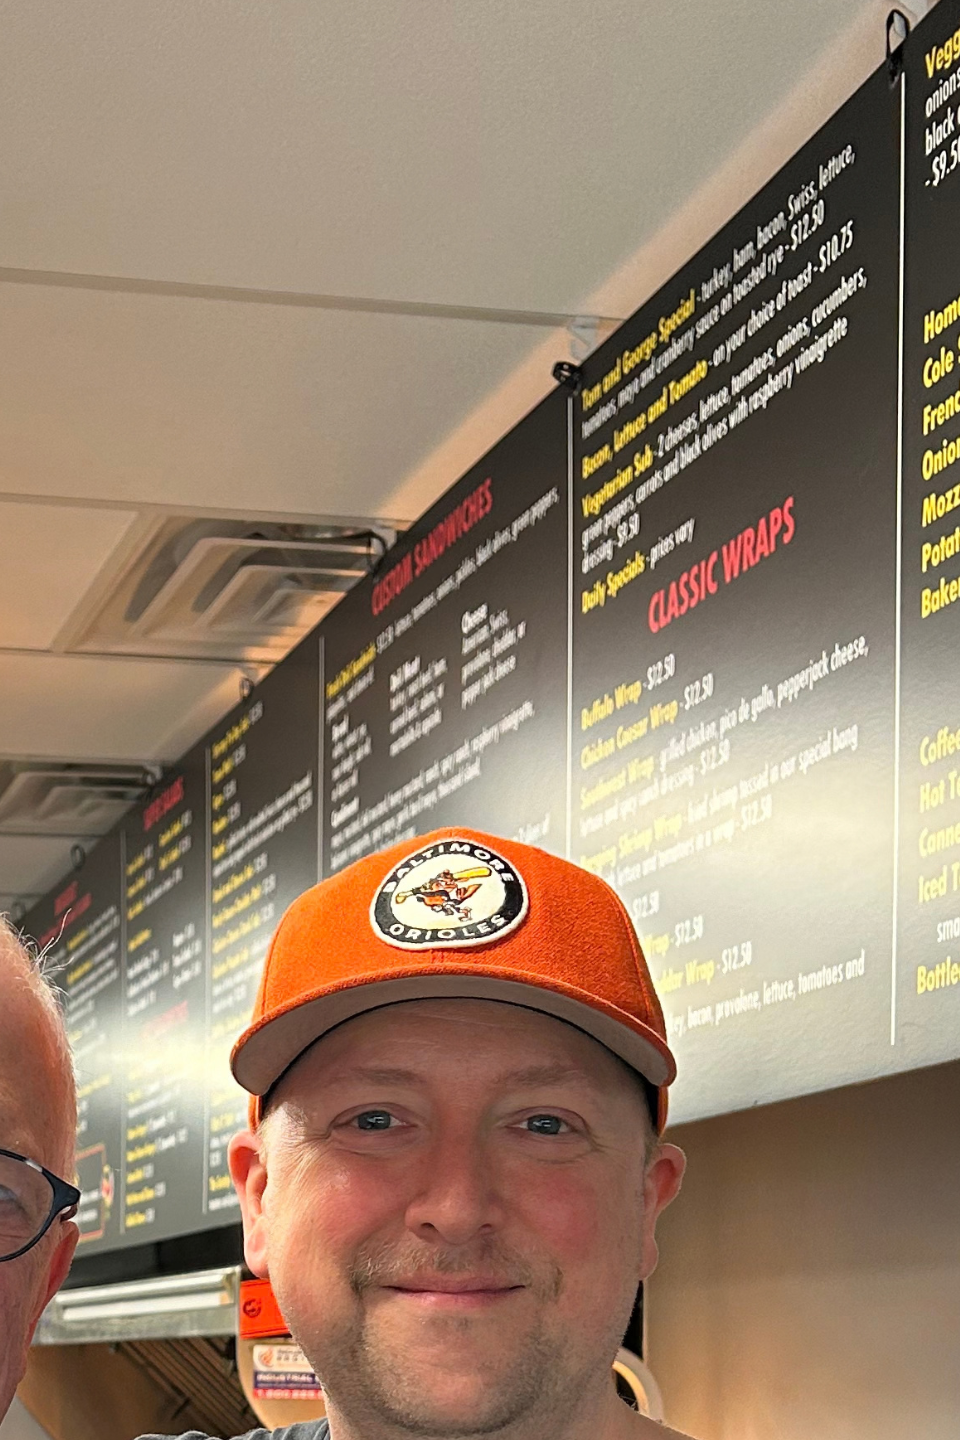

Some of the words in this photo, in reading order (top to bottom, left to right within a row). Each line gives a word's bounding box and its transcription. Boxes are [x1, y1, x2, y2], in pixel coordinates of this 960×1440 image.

[926, 106, 955, 156] black
[602, 358, 622, 393] and
[622, 332, 658, 374] George
[658, 289, 695, 342] Special
[701, 263, 733, 302] turkey,
[733, 241, 756, 272] ham,
[757, 212, 787, 250] bacon,
[787, 181, 818, 221] Swiss,
[818, 145, 855, 190] lettuce,
[655, 328, 695, 374] cranberry
[695, 305, 720, 339] sauce
[720, 293, 733, 316] on
[732, 253, 767, 304] toasted
[767, 245, 784, 275] rye
[790, 199, 825, 251] $12.50
[582, 445, 613, 479] Bacon,
[613, 413, 647, 452] Lettuce
[647, 387, 668, 423] and
[668, 360, 708, 404] Tomato
[712, 344, 726, 367] on
[725, 325, 747, 362] your
[747, 300, 775, 337] choice
[776, 280, 787, 311] of
[787, 262, 812, 301] toast
[819, 220, 853, 273] $10.75
[923, 346, 955, 388] Cole
[581, 466, 633, 517] Vegetarian
[633, 445, 654, 477] Sub
[657, 434, 665, 458] 2
[664, 413, 698, 452] cheeses,
[699, 387, 731, 422] lettuce,
[731, 348, 776, 396] tomatoes,
[776, 317, 811, 358] onions,
[811, 268, 867, 327] cucumbers,
[635, 470, 665, 504] carrots
[663, 451, 680, 482] and
[679, 434, 702, 469] black
[701, 418, 728, 451] olives
[728, 396, 749, 429] with
[748, 363, 794, 413] raspberry
[794, 318, 848, 373] vinaigrette
[371, 555, 413, 615] CUSTOM
[414, 480, 493, 575] SANDWICHES
[581, 581, 607, 614] Daily
[606, 552, 645, 597] Specials
[650, 533, 675, 569] prices
[674, 519, 695, 545] vary
[648, 553, 718, 633] CLASSIC
[721, 496, 796, 584] WRAPS
[922, 576, 960, 619] Bake
[580, 694, 615, 731] Buffalo
[614, 680, 642, 710] Wrap
[646, 654, 676, 691] $12.50
[627, 755, 655, 784] Wrap
[659, 733, 686, 772] grilled
[686, 721, 719, 753] chicken,
[719, 709, 738, 735] pico
[738, 697, 750, 722] de
[750, 685, 776, 723] gallo,
[776, 651, 829, 709] pepperjack
[830, 636, 869, 671] cheese,
[581, 738, 616, 770] Chicken
[616, 717, 649, 750] Caesar
[649, 700, 678, 734] Wrap
[683, 673, 714, 711] $12.50
[700, 738, 731, 776] $12.50
[780, 757, 797, 779] our
[798, 731, 832, 774] special
[832, 723, 859, 758] bang
[740, 794, 773, 832] $12.50
[920, 779, 945, 814] Hot
[382, 842, 514, 893] BALTIMORE
[919, 864, 947, 902] Iced
[389, 914, 508, 941] ORIOLES
[631, 890, 660, 923] $12.50
[674, 914, 704, 948] $12.50
[685, 960, 715, 986] Wrap
[721, 941, 753, 975] $12.50
[687, 1003, 715, 1030] bacon,
[715, 988, 762, 1025] provolone,
[762, 980, 796, 1005] lettuce,
[797, 964, 844, 994] tomatoes
[845, 948, 866, 980] and
[917, 955, 960, 995] Bottle
